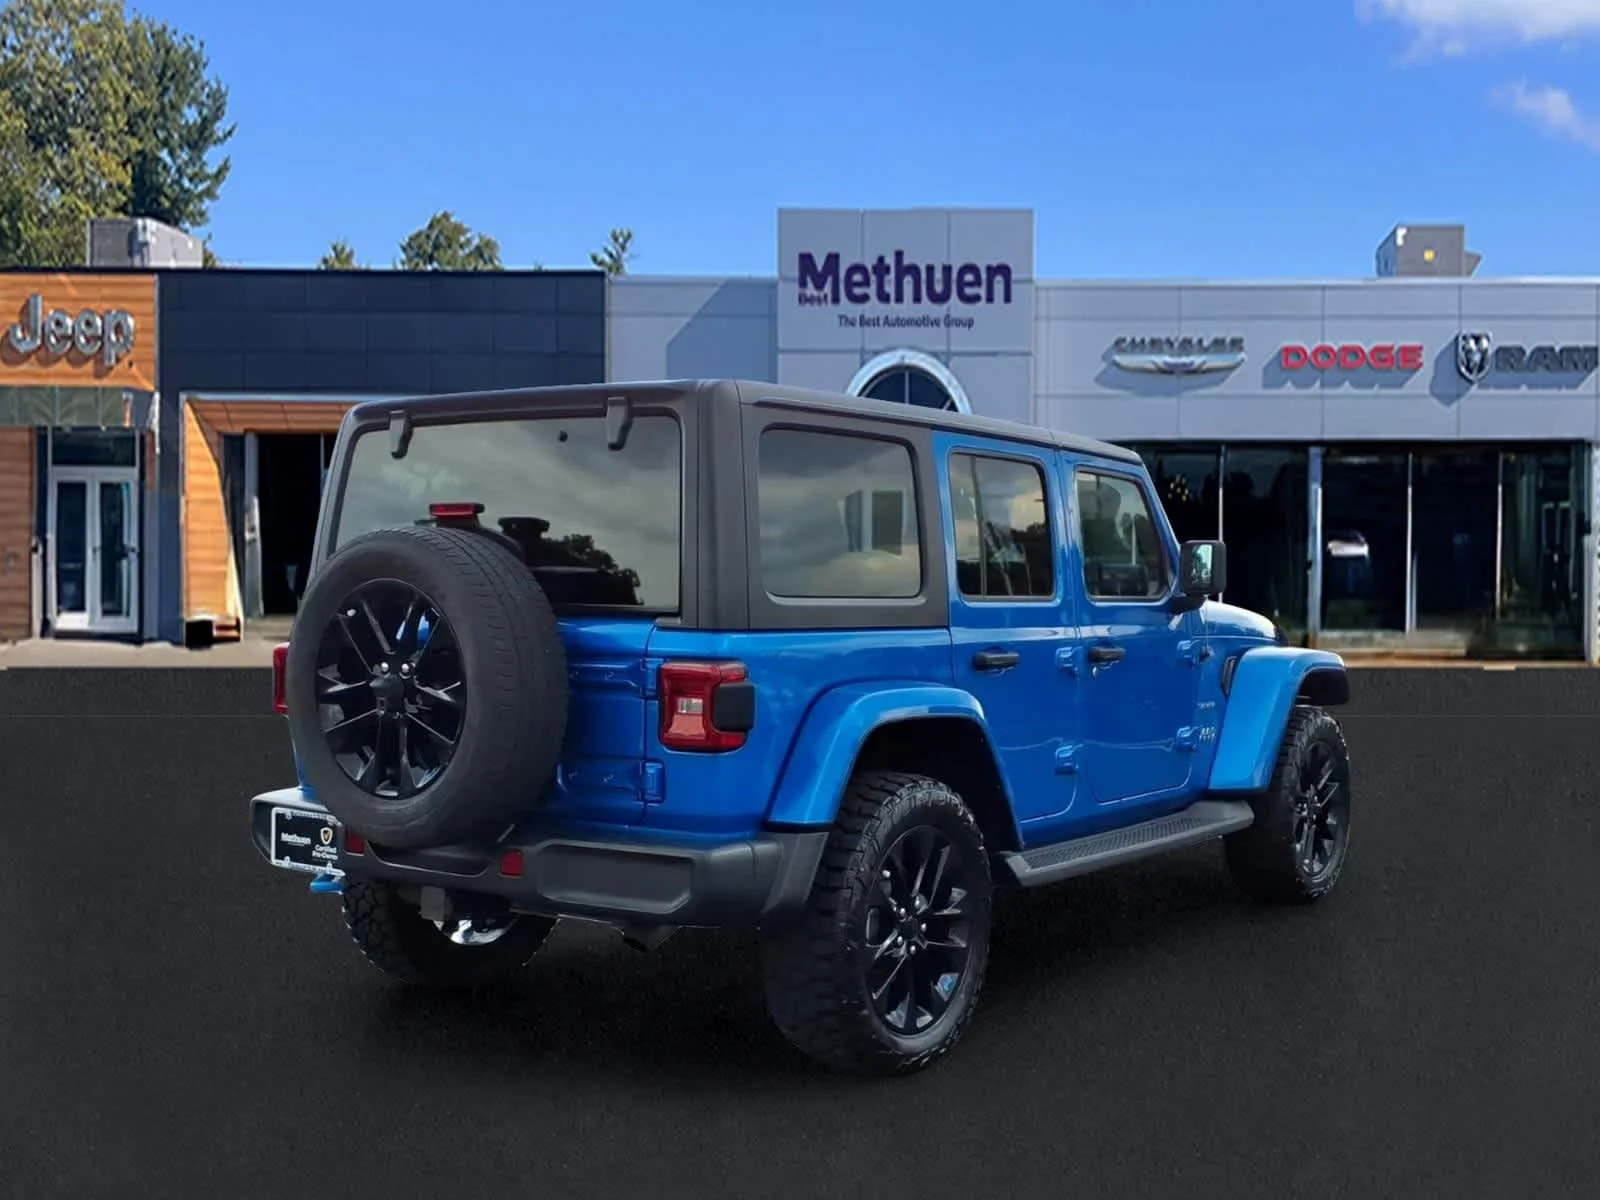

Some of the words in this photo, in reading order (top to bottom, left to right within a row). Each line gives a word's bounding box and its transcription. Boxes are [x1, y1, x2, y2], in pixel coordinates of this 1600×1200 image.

[798, 250, 1012, 305] Methuen
[9, 294, 135, 366] Jeep
[838, 314, 856, 328] The
[859, 314, 880, 328] Best
[882, 315, 940, 328] Automotive
[943, 314, 974, 330] Group
[1281, 345, 1424, 369] DODGE
[1496, 345, 1599, 371] RAM
